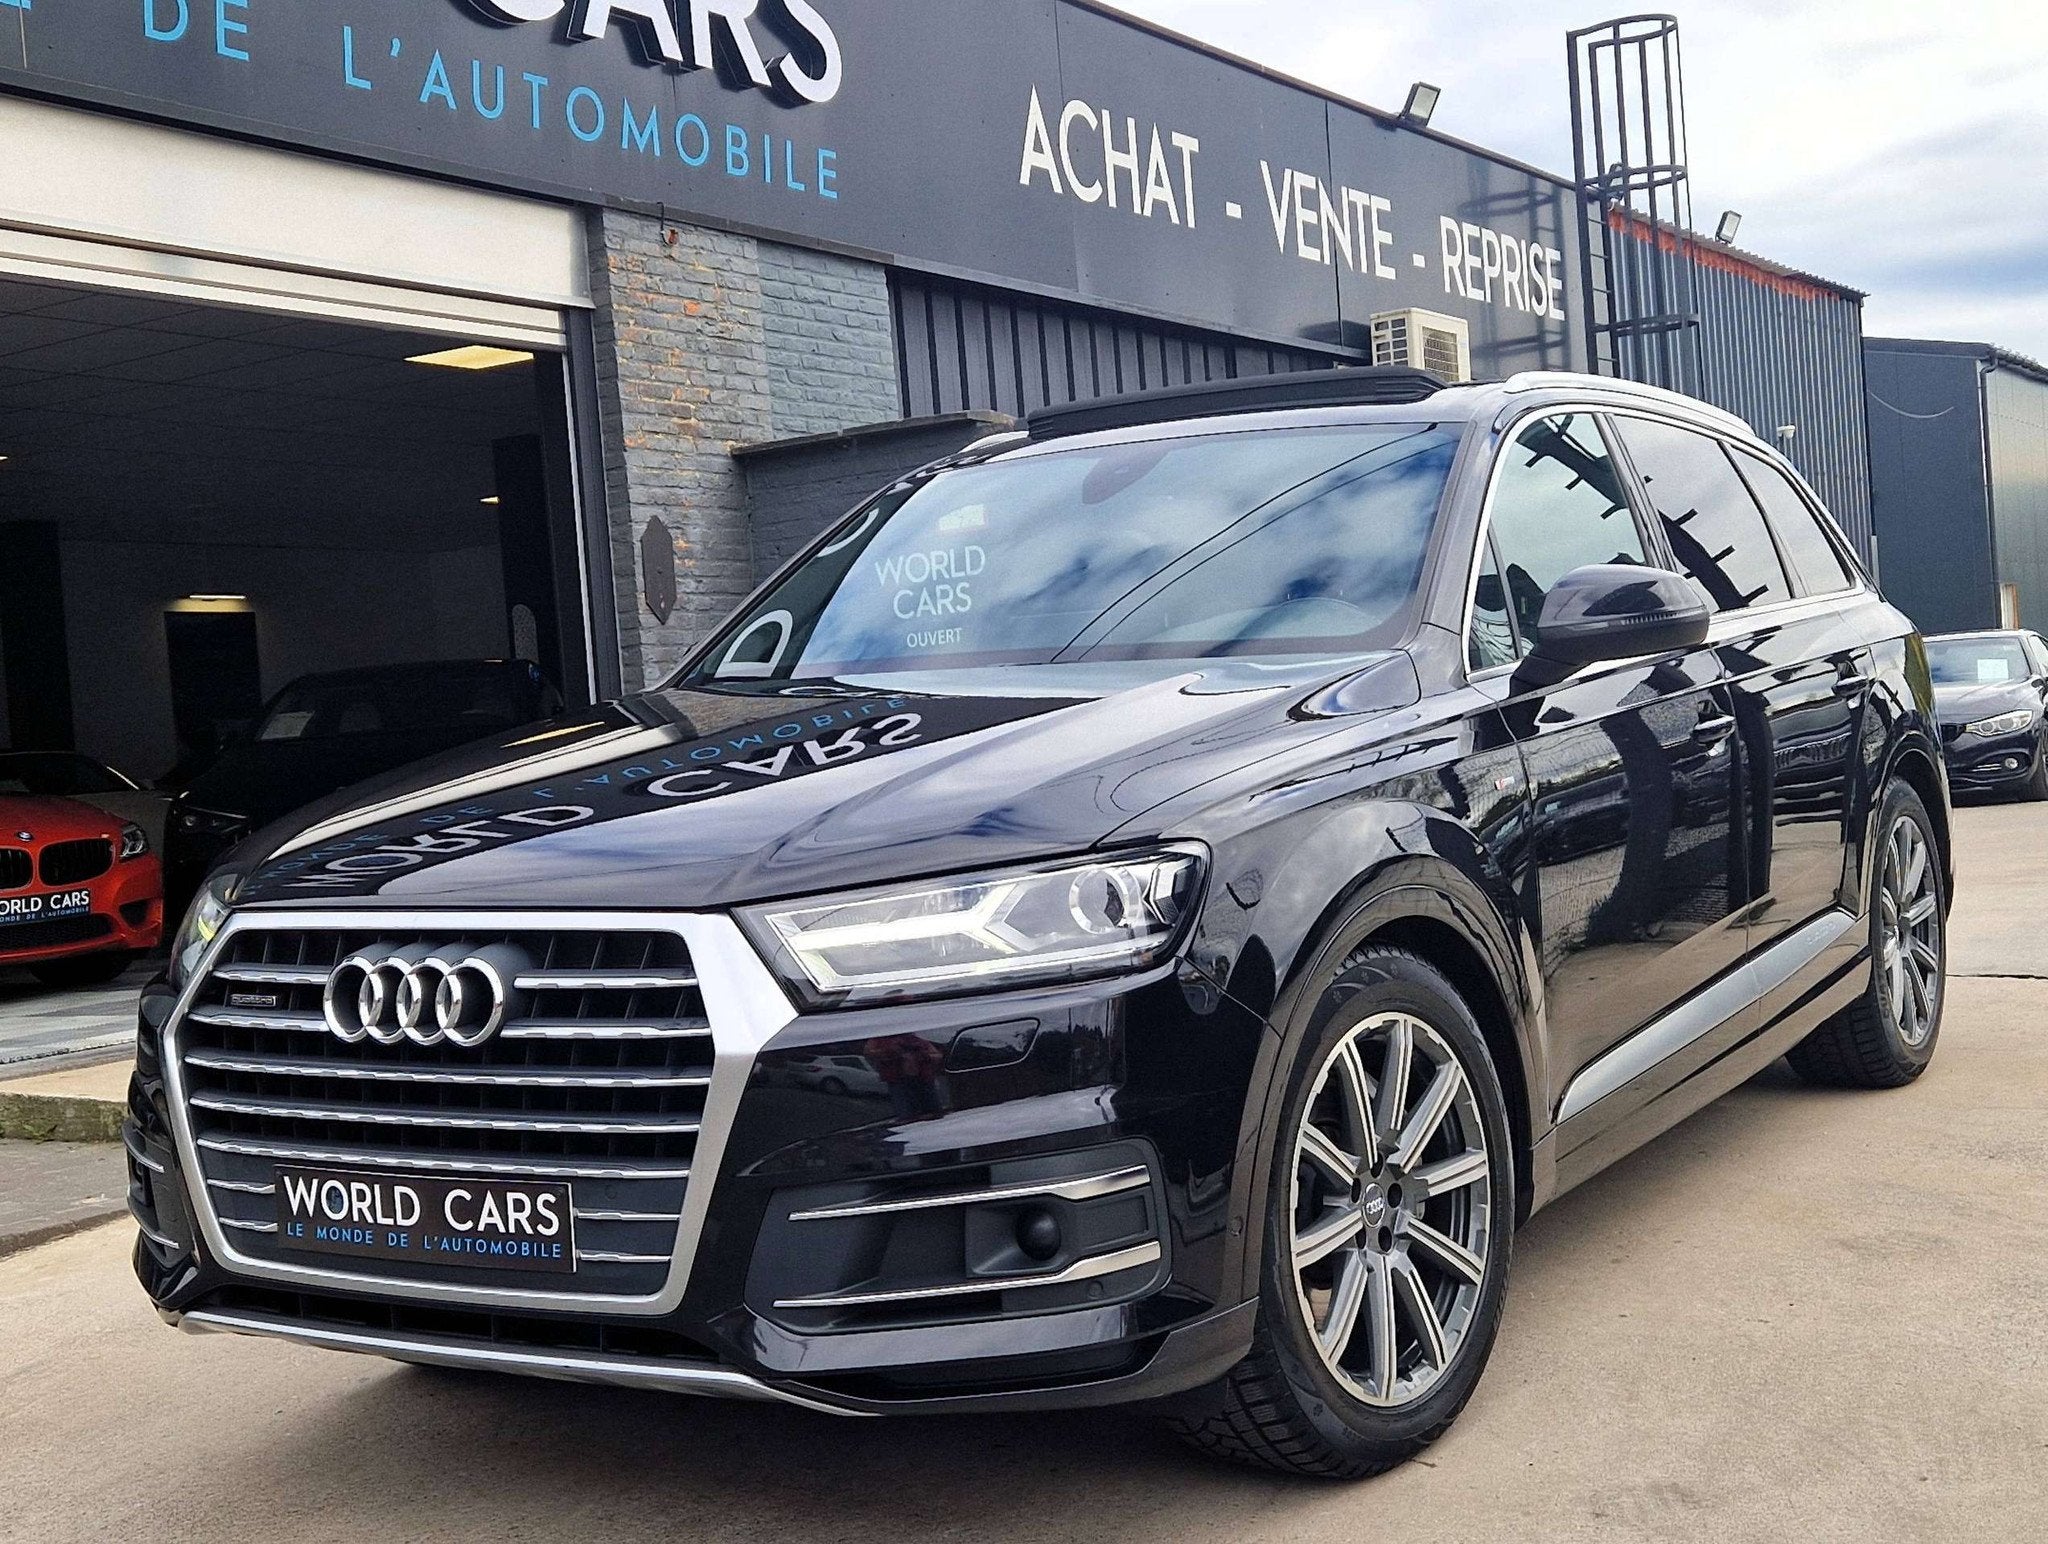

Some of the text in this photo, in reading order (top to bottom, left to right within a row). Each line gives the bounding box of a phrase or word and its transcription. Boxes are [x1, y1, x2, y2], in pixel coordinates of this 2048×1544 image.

[343, 26, 839, 199] L'AUTOMOBILE
[1019, 84, 1199, 228] ACHAT
[1260, 160, 1397, 280] VENTE
[1440, 215, 1566, 320] REPRISE
[874, 545, 986, 587] WORLD
[893, 582, 972, 619] CARS
[907, 627, 963, 648] OUVERT
[50, 891, 89, 909] CARS
[283, 1175, 560, 1236] WORLD CARS
[287, 1222, 562, 1258] LE MONDE DE L'AUTOMOBILE
